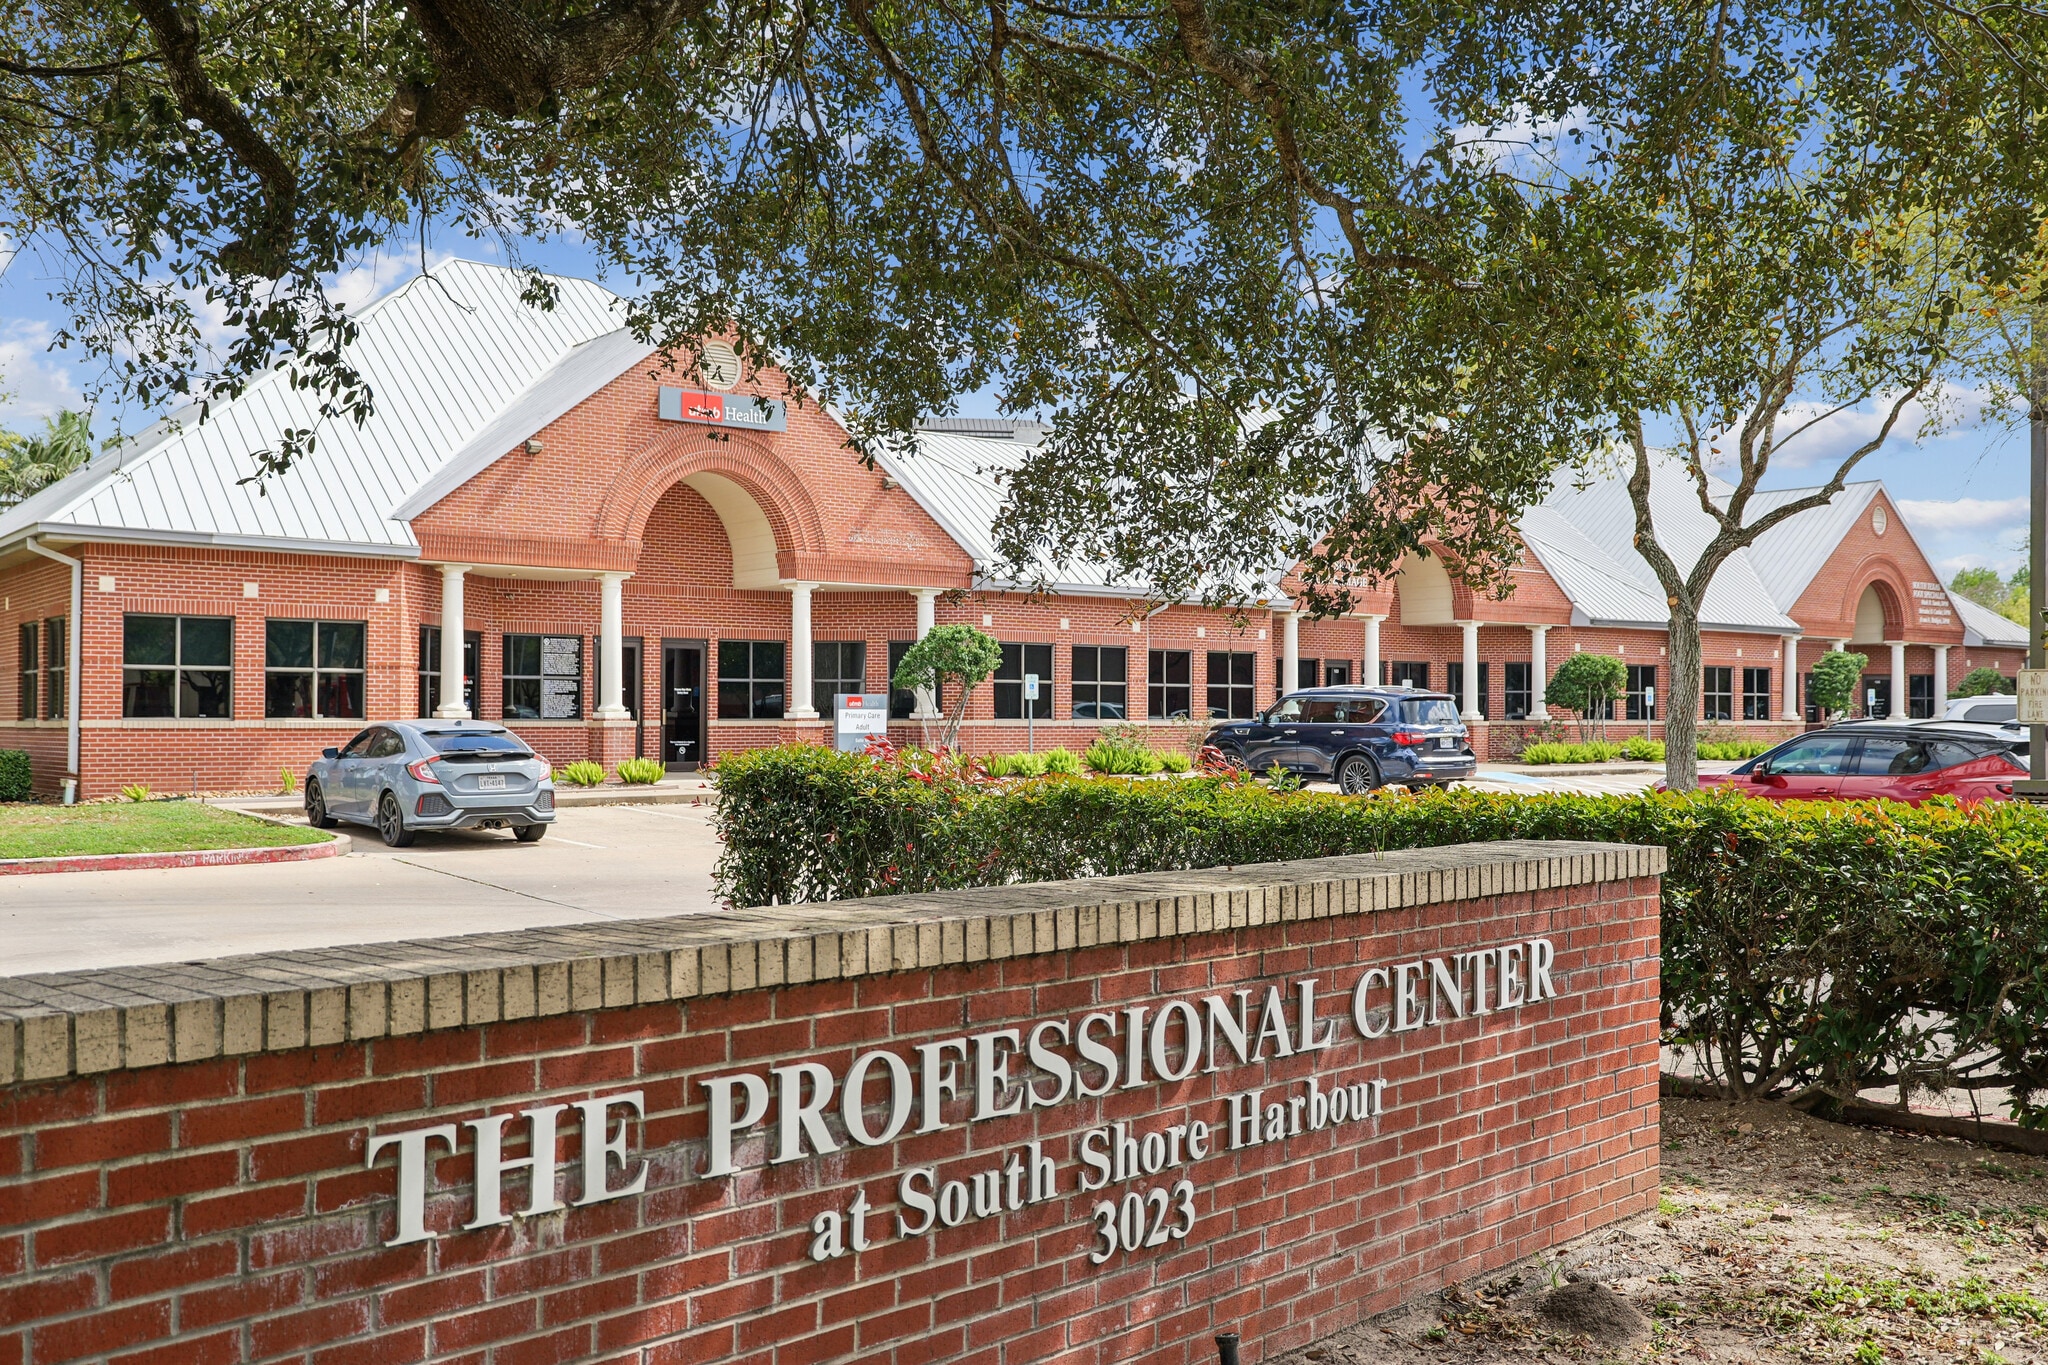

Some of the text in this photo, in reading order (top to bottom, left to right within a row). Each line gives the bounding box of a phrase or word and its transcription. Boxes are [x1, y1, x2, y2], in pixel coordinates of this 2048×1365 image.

[725, 406, 766, 424] Health
[2030, 674, 2041, 686] NO
[2020, 688, 2048, 697] PARKIN
[2028, 700, 2042, 709] FIRE
[845, 712, 866, 720] Primary
[2027, 710, 2043, 719] LANE
[367, 938, 1558, 1248] THE PROFESSIONAL CENTER
[808, 1077, 1388, 1262] at South Shore Harbour
[1089, 1179, 1196, 1264] 3023
